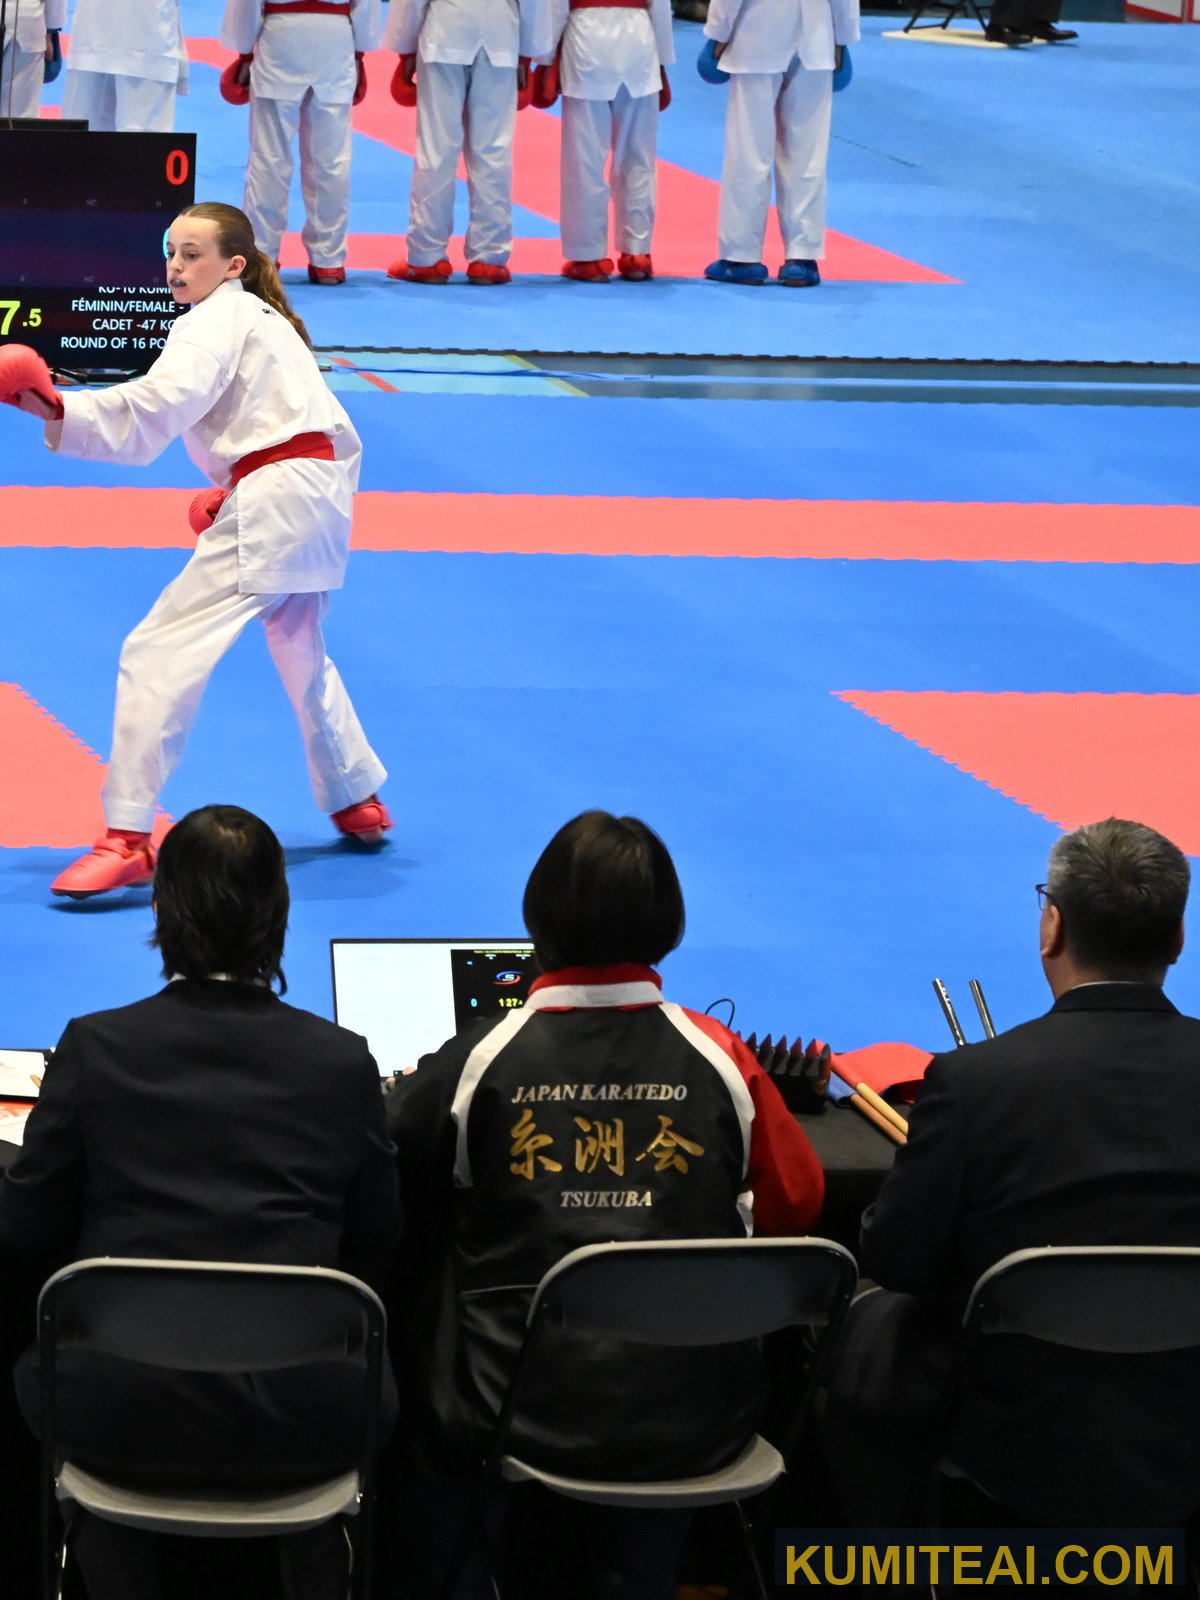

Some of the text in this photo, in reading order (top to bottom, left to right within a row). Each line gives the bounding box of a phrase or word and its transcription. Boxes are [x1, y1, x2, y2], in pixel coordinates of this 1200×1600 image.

[165, 149, 189, 186] 0
[71, 297, 176, 313] FÉMININ/FEMALE
[92, 318, 133, 331] CADET
[136, 319, 157, 331] -47
[61, 336, 167, 350] ROUND OF 16 PO
[511, 1084, 688, 1103] JAPAN KARATEDO
[560, 1190, 652, 1208] TSUKUBA
